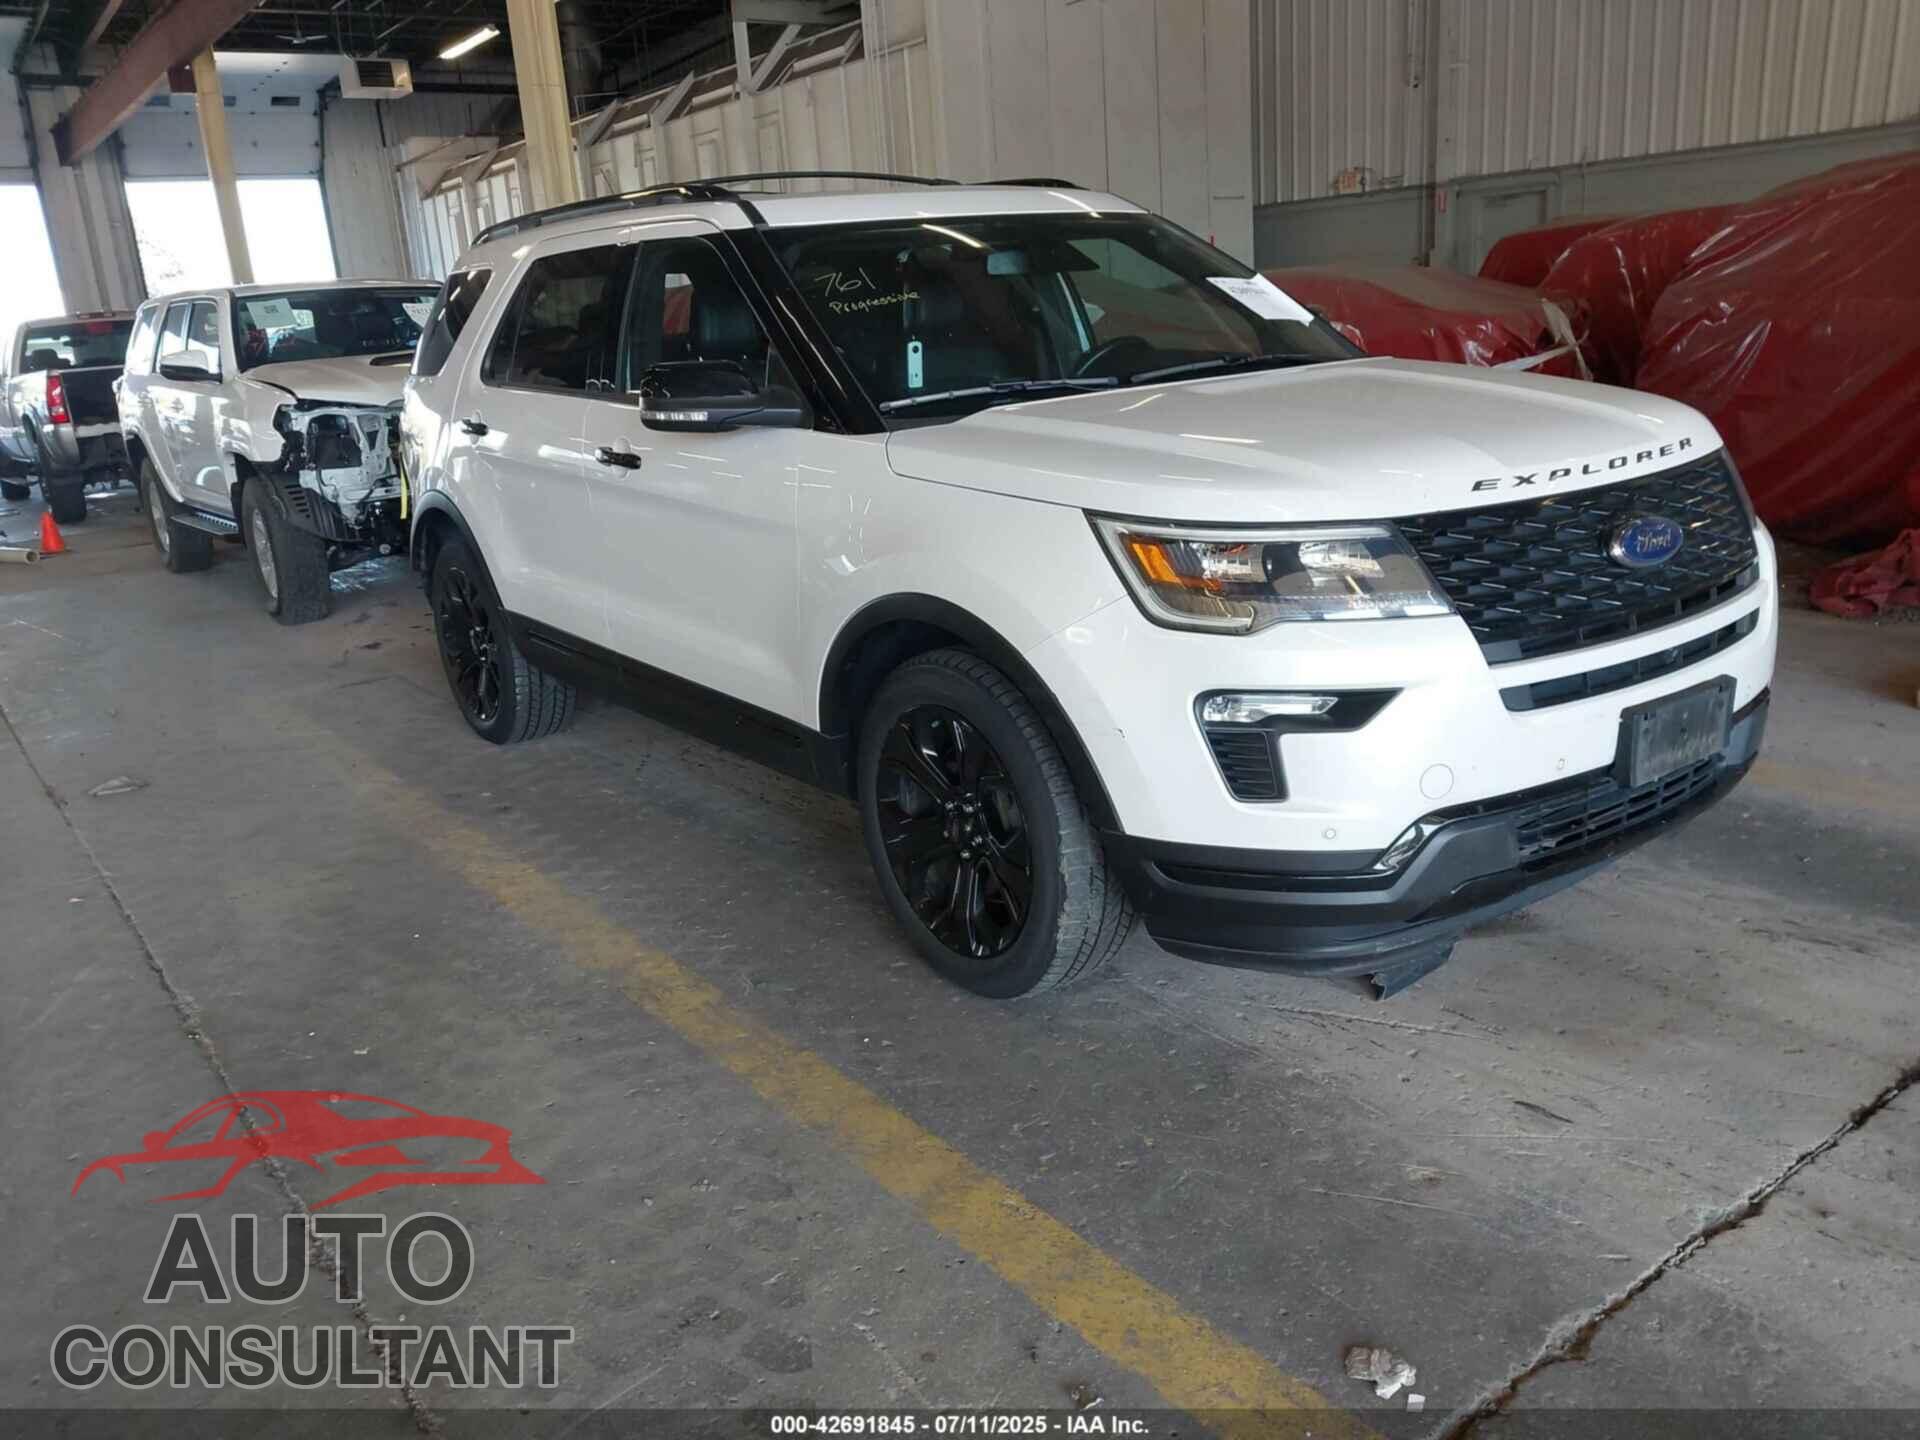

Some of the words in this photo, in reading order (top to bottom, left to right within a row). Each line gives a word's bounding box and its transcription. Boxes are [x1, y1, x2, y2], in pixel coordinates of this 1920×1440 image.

[814, 267, 876, 297] 761
[1471, 437, 1693, 491] EXPLORER
[1633, 526, 1672, 553] Ford
